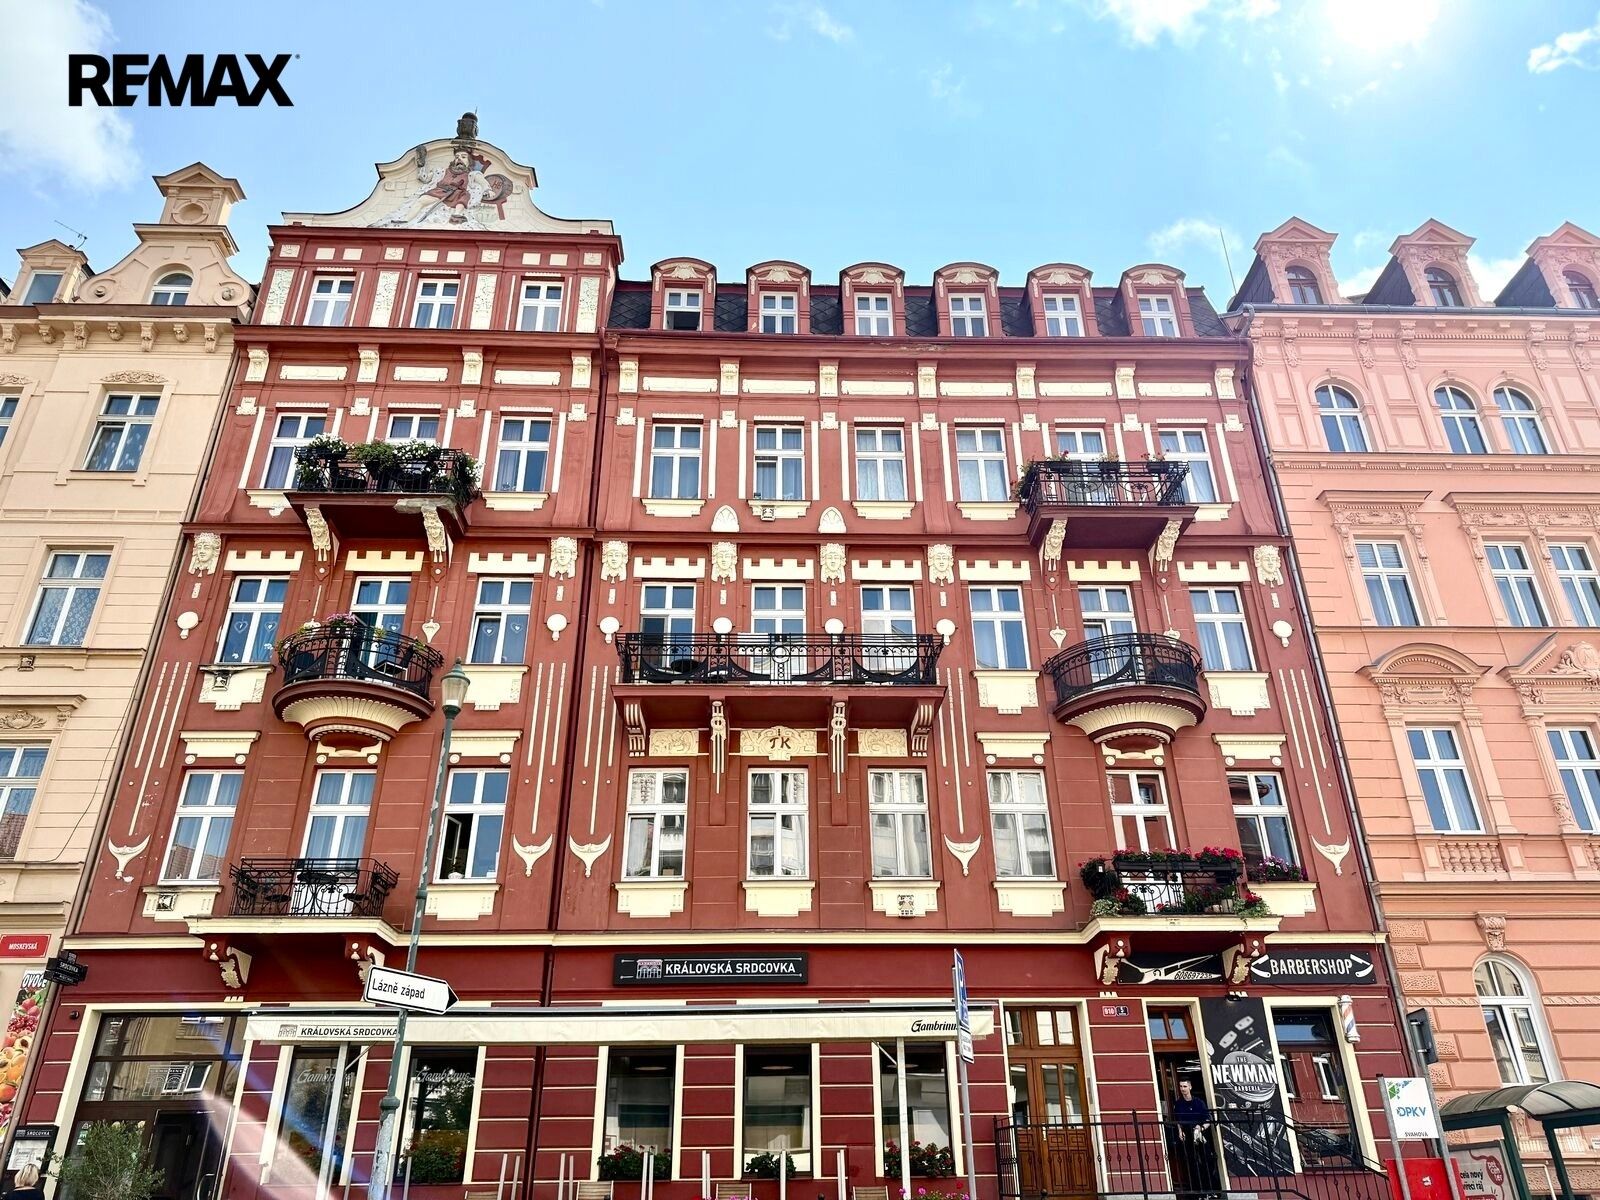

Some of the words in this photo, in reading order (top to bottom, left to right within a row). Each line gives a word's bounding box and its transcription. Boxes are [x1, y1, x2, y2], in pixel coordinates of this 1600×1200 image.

[8, 941, 38, 950] MOSKEVSKÁ
[665, 960, 733, 975] KRÁLOVSKÁ
[736, 962, 796, 974] SRDCOVKA
[1270, 959, 1353, 975] BARBERSHOP
[372, 978, 398, 994] Lázně
[400, 984, 426, 999] západ
[301, 1026, 351, 1036] KRÁLOVSKÁ
[353, 1028, 398, 1036] SRDCOVKA
[911, 1020, 958, 1033] Gambrinu
[1211, 1064, 1278, 1085] NEWMAN
